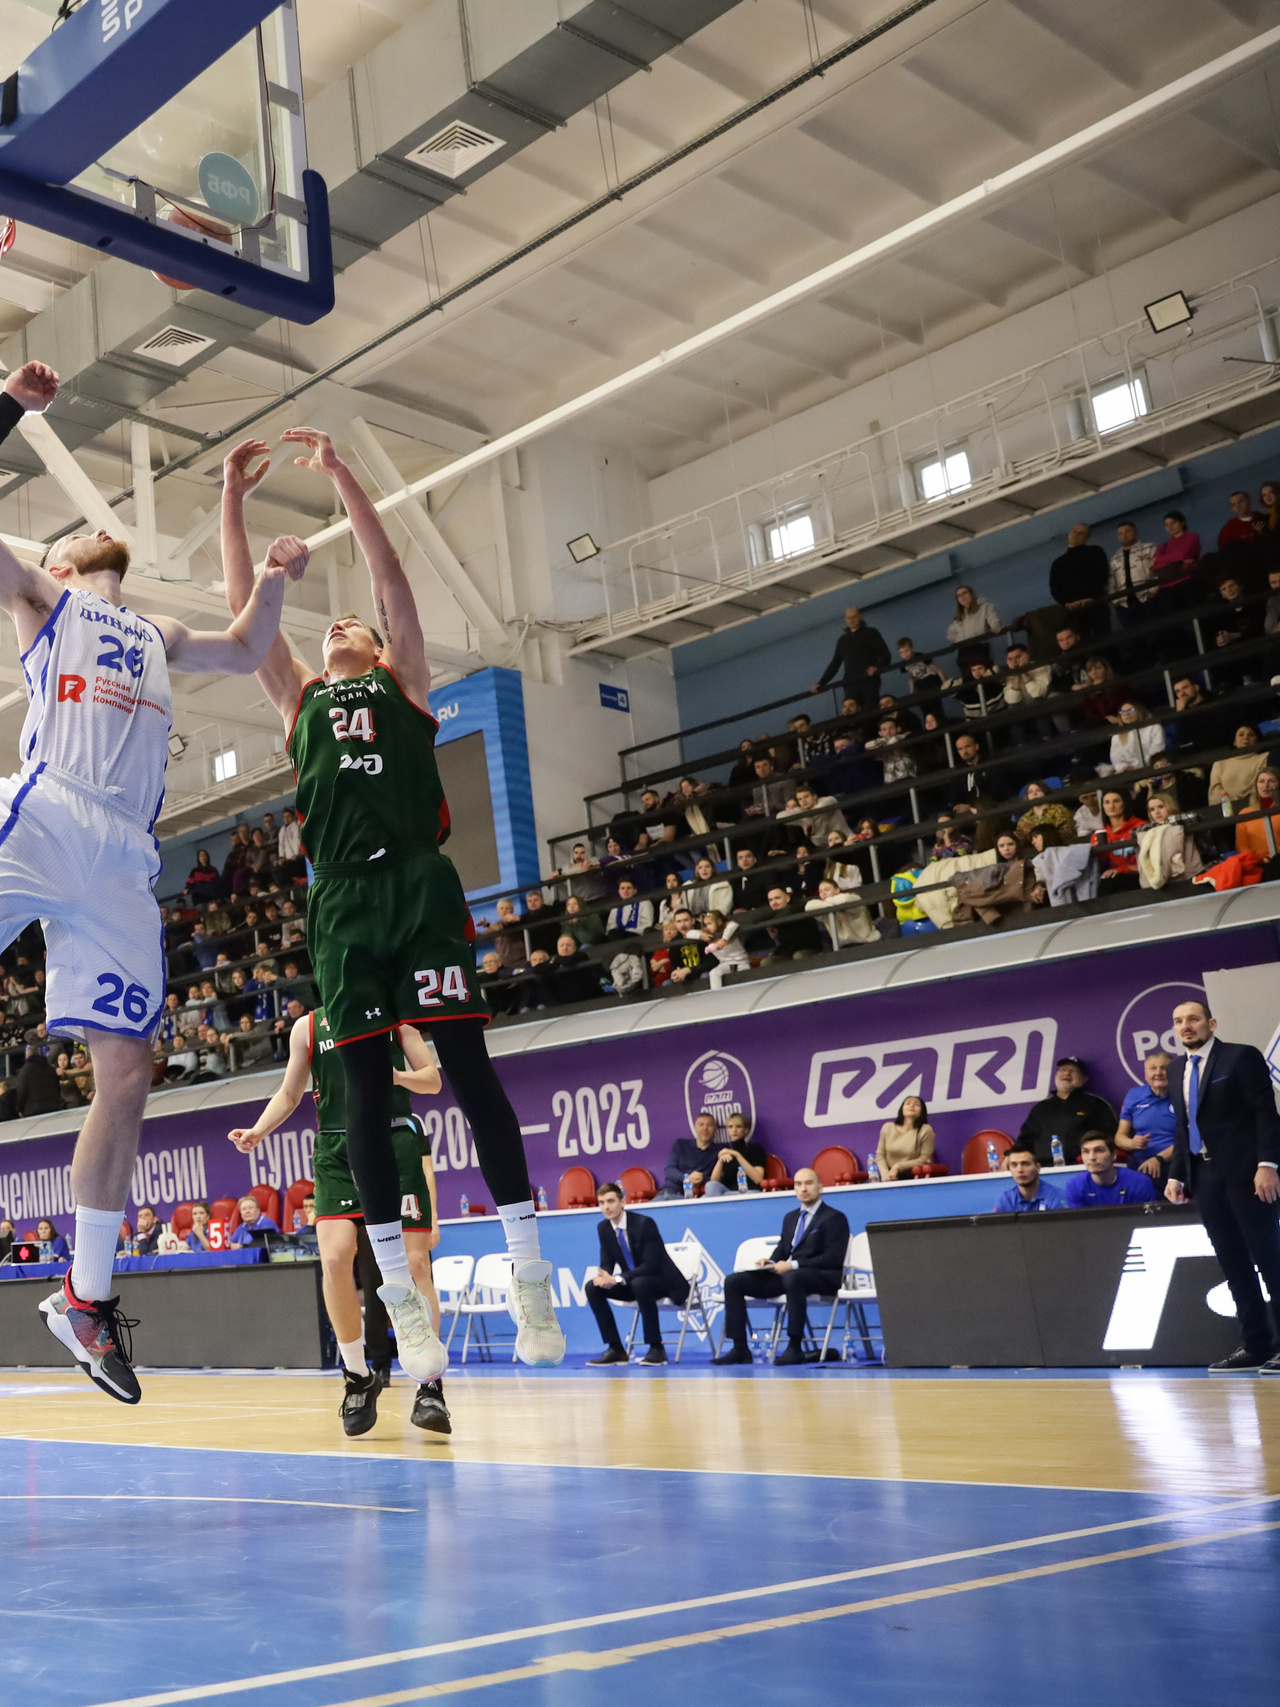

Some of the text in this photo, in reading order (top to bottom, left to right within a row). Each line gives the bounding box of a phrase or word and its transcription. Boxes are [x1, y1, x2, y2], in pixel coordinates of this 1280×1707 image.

[97, 634, 144, 679] 26
[95, 676, 131, 692] Русская
[93, 695, 134, 715] Компания
[328, 707, 377, 742] 24
[91, 972, 150, 1023] 26
[414, 965, 471, 1007] 24
[814, 1030, 1044, 1116] PARI
[400, 1194, 422, 1220] 4
[209, 1222, 222, 1249] 5
